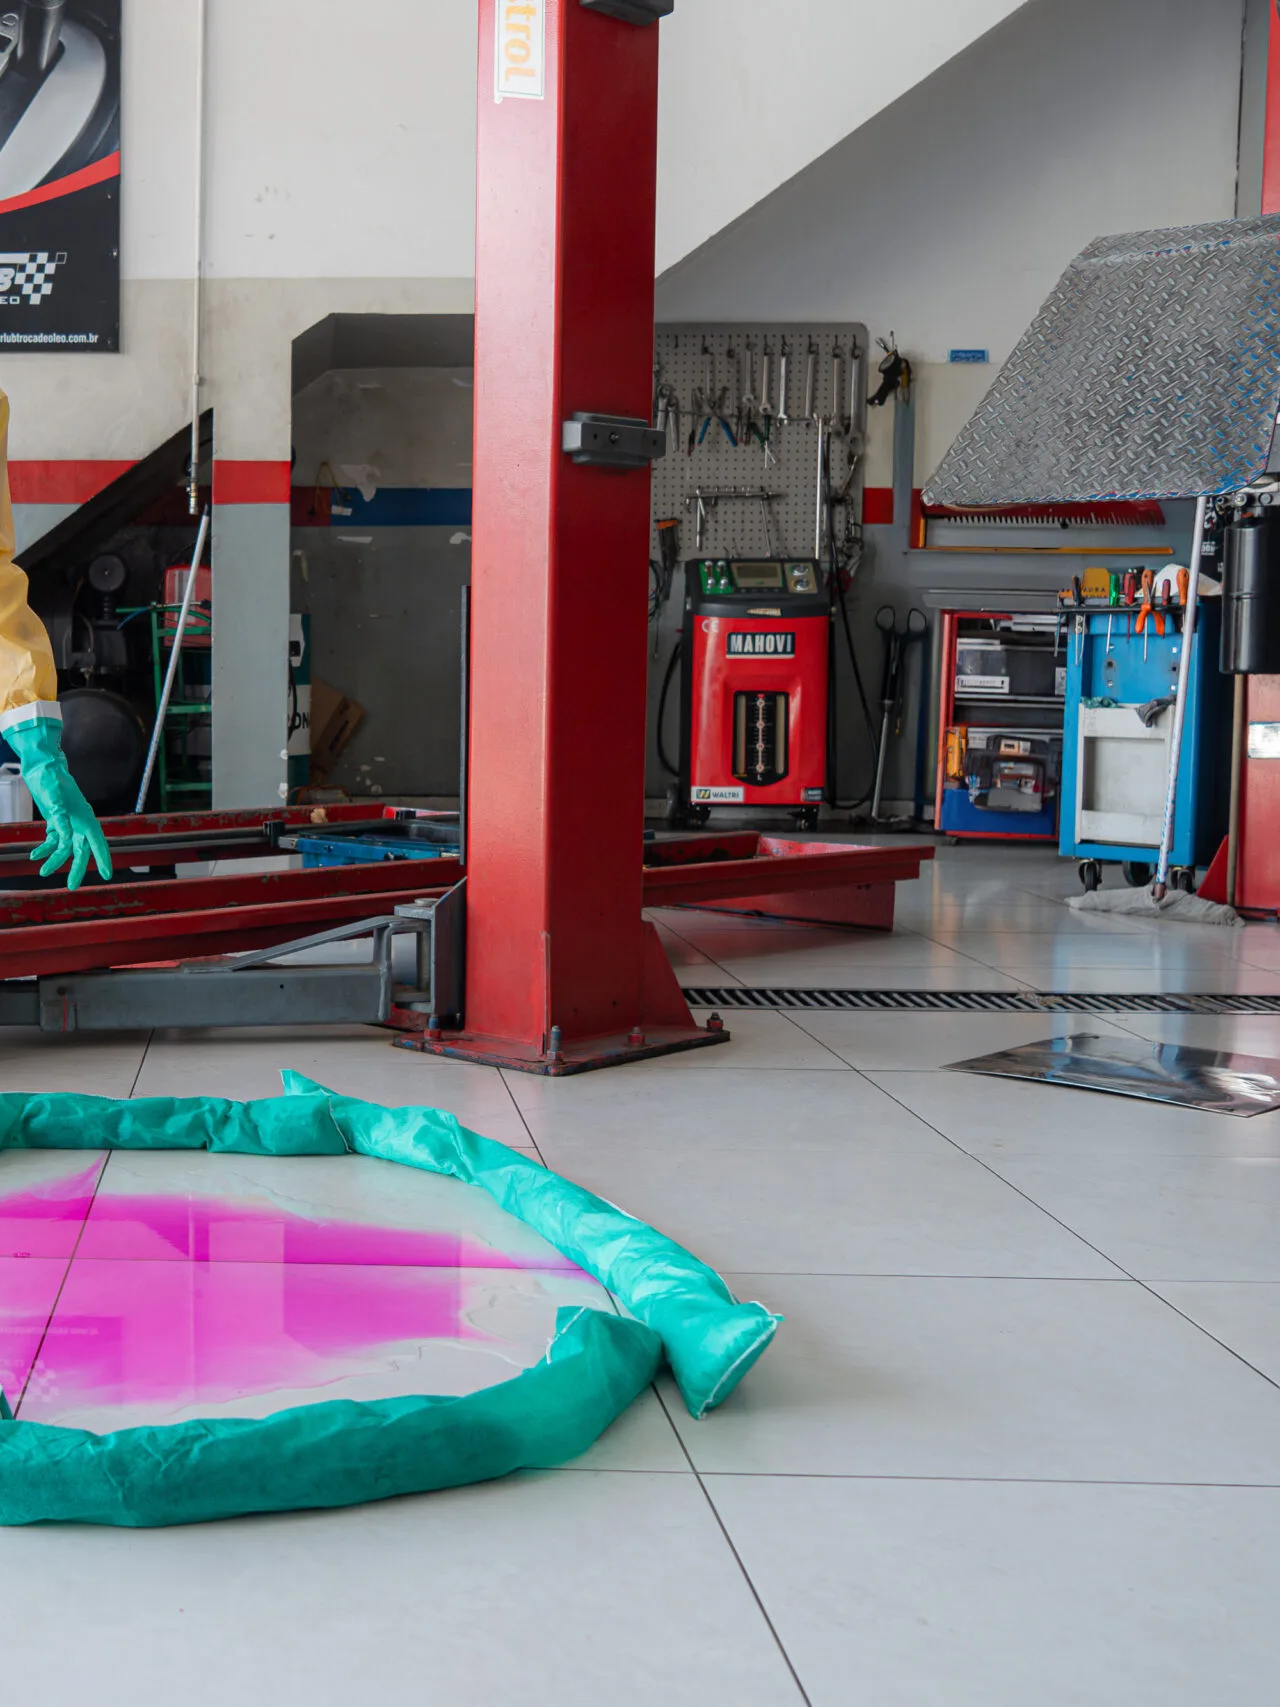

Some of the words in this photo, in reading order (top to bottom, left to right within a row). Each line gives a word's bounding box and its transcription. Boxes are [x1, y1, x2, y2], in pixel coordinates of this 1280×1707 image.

[504, 0, 537, 82] trol
[730, 634, 793, 653] MAHOVI
[712, 791, 740, 799] WALTRI
